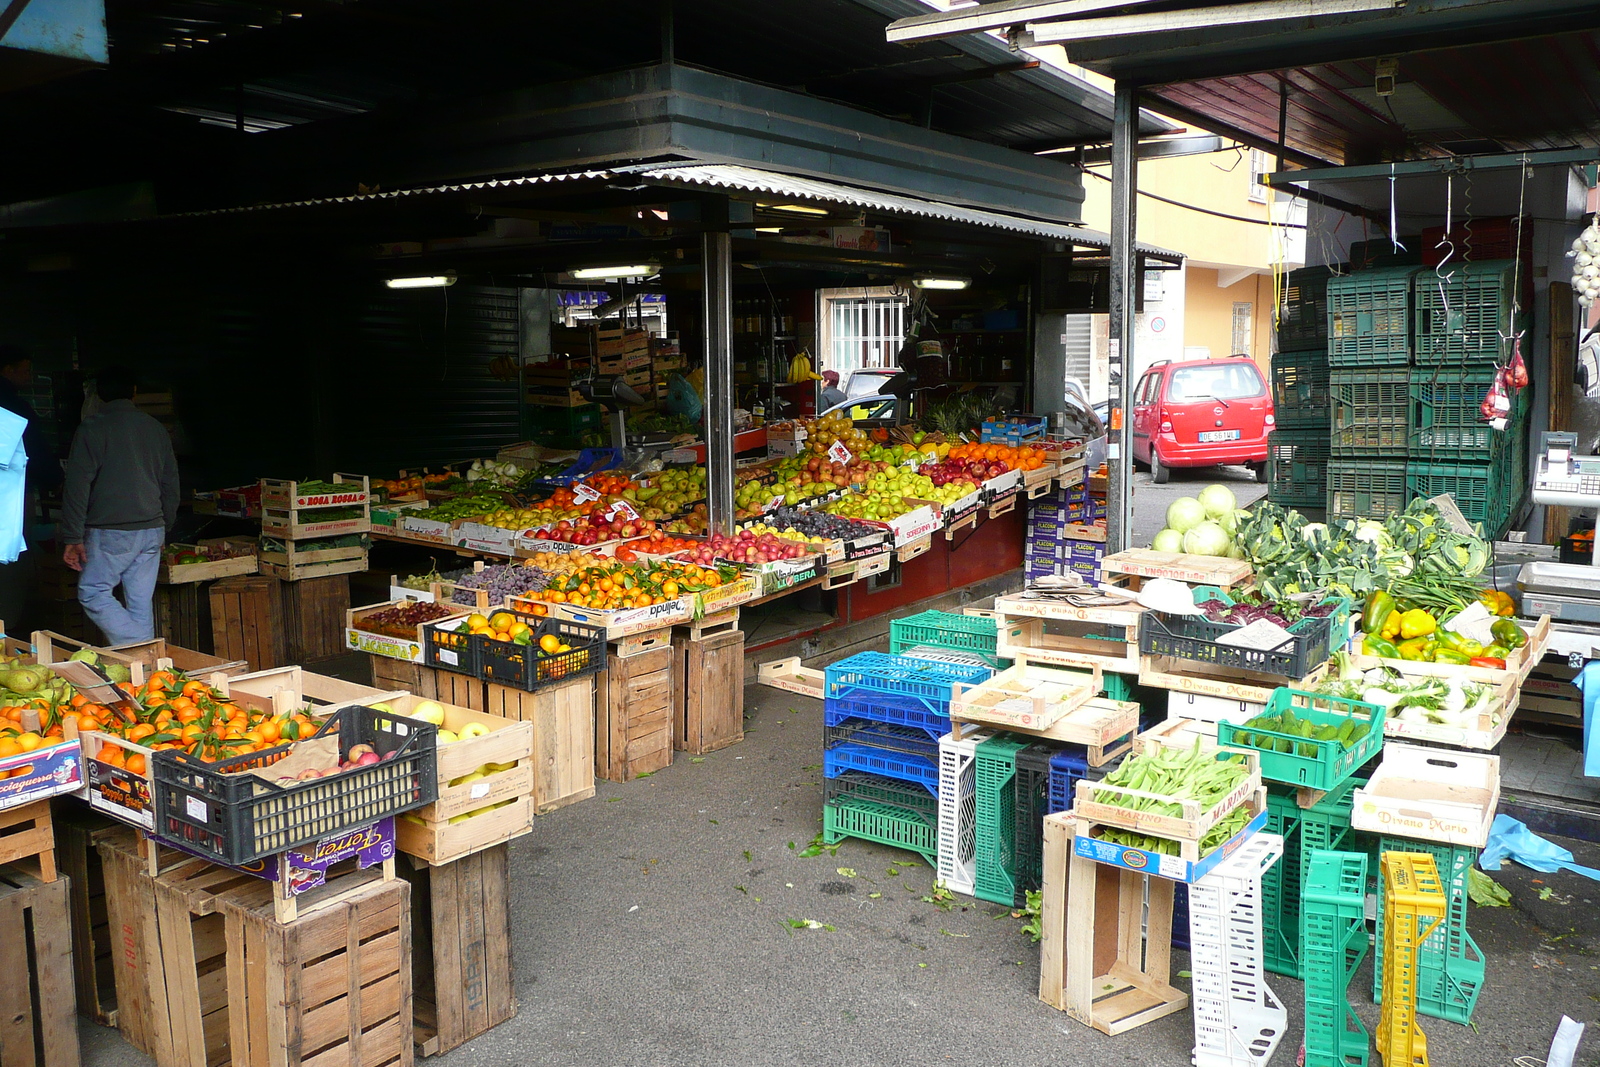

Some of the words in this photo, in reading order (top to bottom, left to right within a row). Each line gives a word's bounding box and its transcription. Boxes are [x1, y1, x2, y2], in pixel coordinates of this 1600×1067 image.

[1203, 432, 1212, 440] DE
[307, 495, 329, 506] ROSA
[332, 494, 358, 504] ROSSA
[1145, 567, 1186, 579] BOLOGNA
[1016, 605, 1047, 616] Mario
[1052, 607, 1089, 619] Divano
[1179, 678, 1221, 693] Divano
[1227, 685, 1264, 699] Mario
[1212, 783, 1249, 823] MARINO
[1115, 809, 1162, 824] MARINO
[1377, 811, 1424, 829] Divano
[1429, 819, 1468, 834] Mario
